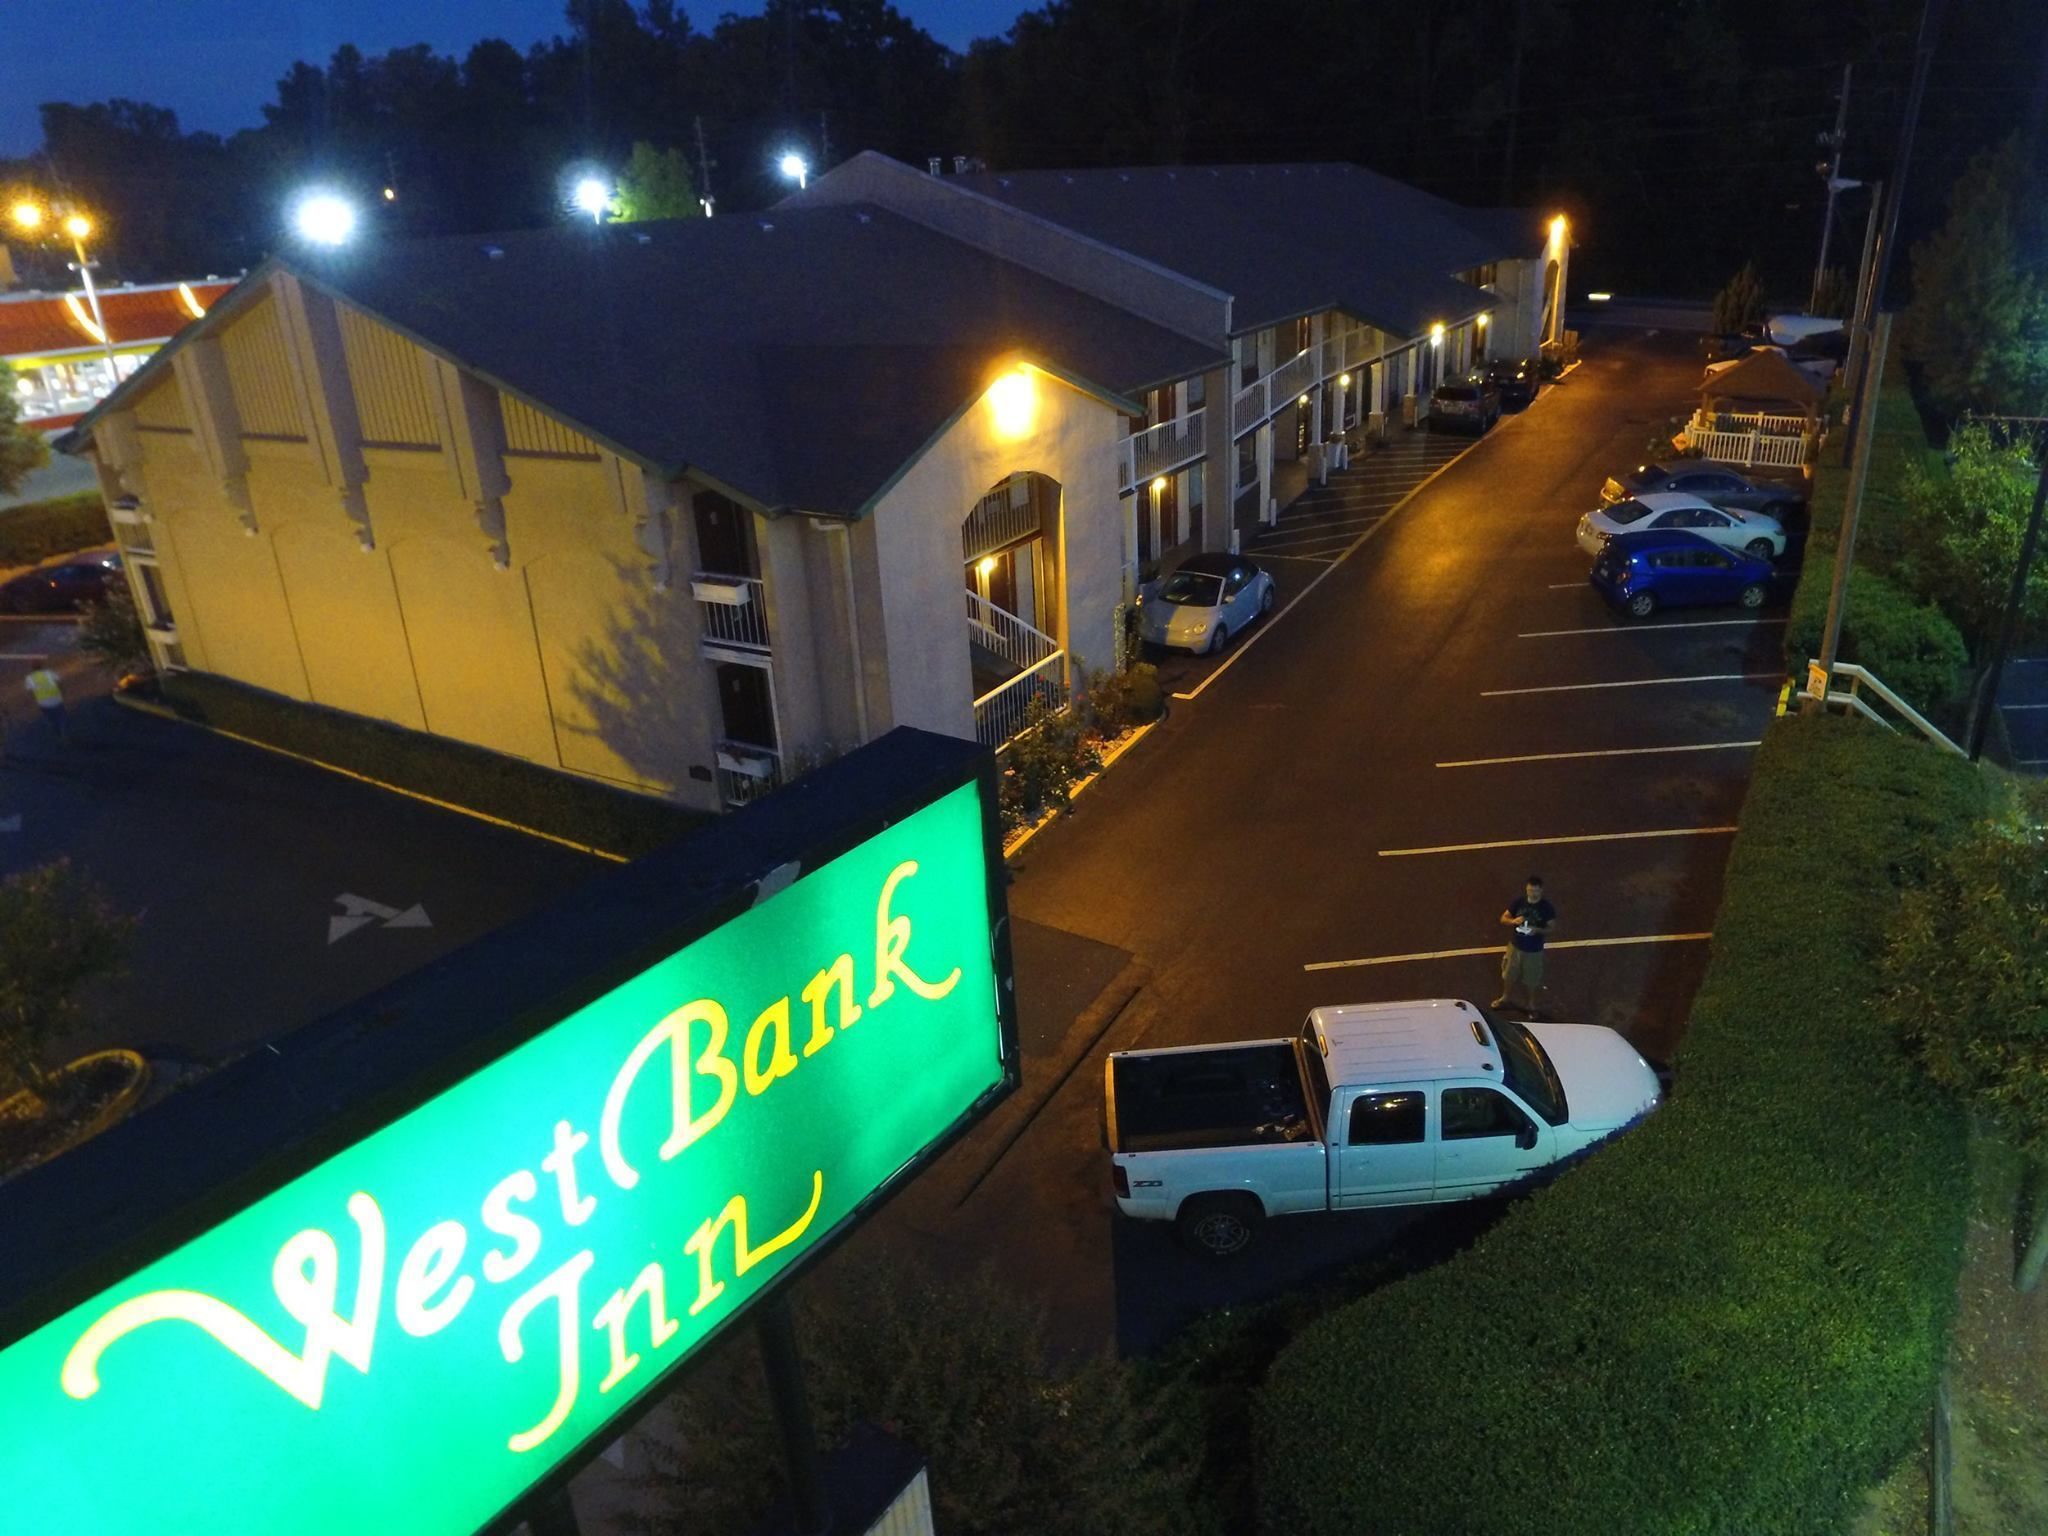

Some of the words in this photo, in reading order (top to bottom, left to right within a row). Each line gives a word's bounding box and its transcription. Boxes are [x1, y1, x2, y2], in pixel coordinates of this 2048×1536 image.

[62, 1120, 595, 1409] West
[601, 860, 961, 1188] Bank
[499, 1170, 823, 1450] Inn
